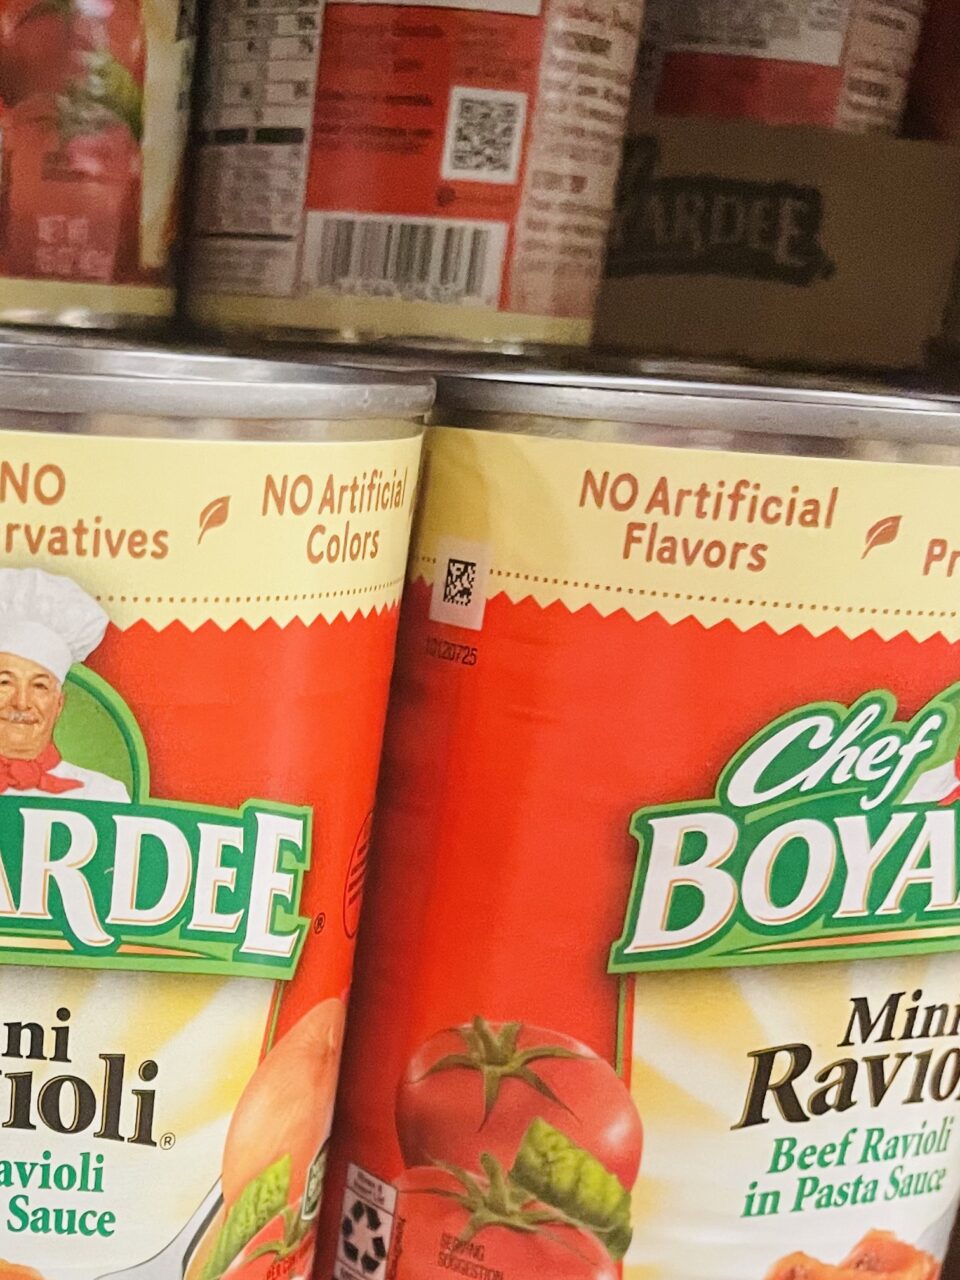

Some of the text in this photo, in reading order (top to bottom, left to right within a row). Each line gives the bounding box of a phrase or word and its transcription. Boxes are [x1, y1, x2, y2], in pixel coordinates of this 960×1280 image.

[262, 466, 408, 516] NO Artificial
[579, 469, 840, 529] NO Artificial
[307, 520, 380, 564] Colors
[621, 522, 769, 574] Flavors
[727, 703, 942, 810] Chef
[766, 1115, 954, 1174] Beef Ravioli
[6, 1196, 117, 1238] Sauce
[740, 1165, 946, 1218] in Pasta Sauce
